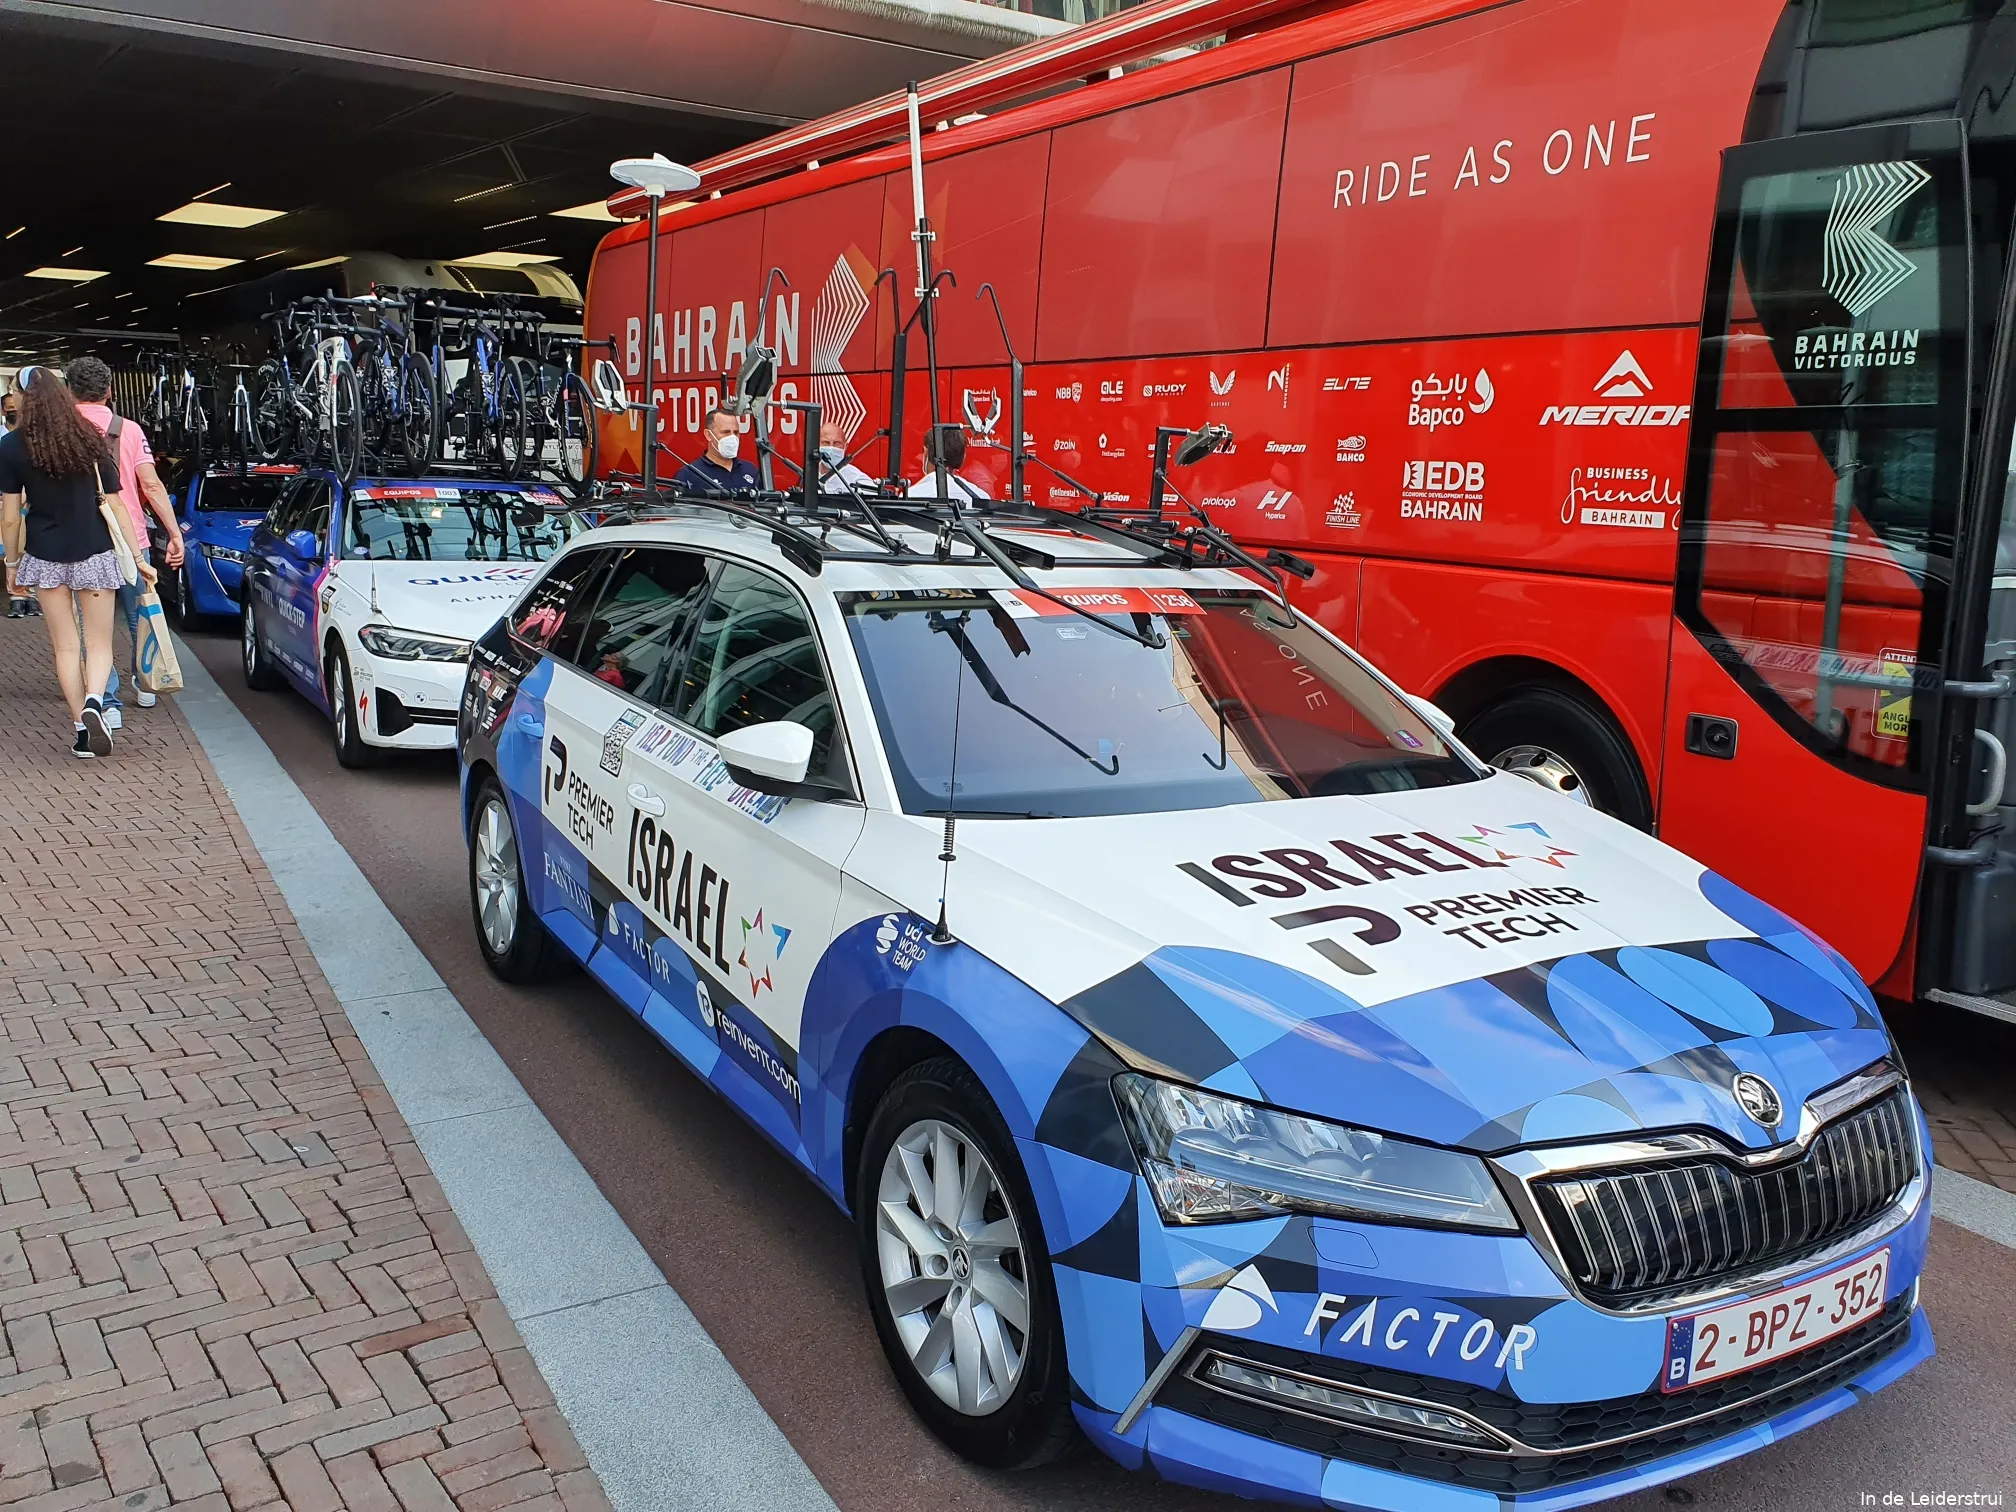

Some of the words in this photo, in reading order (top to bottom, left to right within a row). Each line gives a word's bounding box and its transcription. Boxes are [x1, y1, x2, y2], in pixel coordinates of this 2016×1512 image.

[1333, 154, 1431, 209] RIDE
[1453, 139, 1513, 190] AS
[1543, 112, 1656, 175] ONE
[626, 291, 800, 376] BAHRAIN
[1795, 329, 1920, 354] BAHRAIN
[1794, 350, 1917, 370] VICTORIOUS
[1055, 387, 1072, 400] NBB
[1154, 384, 1186, 393] RUDY
[1322, 376, 1371, 391] ELITE
[1411, 372, 1468, 402] بابكو
[1408, 403, 1464, 433] Bapco
[1264, 441, 1307, 455] Snap-on
[1336, 453, 1365, 462] BAHCO
[1426, 461, 1485, 491] EDB
[1586, 467, 1649, 480] BUSINESS
[383, 489, 422, 497] EQUIPOS
[437, 489, 459, 497] 1003
[1049, 486, 1075, 498] Continental
[1102, 491, 1130, 502] Vision
[1326, 515, 1346, 523] FINISH
[1346, 516, 1361, 524] LINE
[1400, 500, 1483, 522] BAHRAIN
[1591, 511, 1653, 525] BAHRAIN
[1153, 593, 1195, 607] 1258
[279, 597, 306, 629] QUICK-STEP
[635, 722, 672, 755] HELP
[656, 733, 697, 767] FUND
[568, 770, 614, 835] PREMIER
[567, 802, 594, 850] TECH
[1174, 831, 1510, 907] ISRAEL
[543, 851, 595, 921] FANTINI
[627, 807, 730, 977] ISRAEL
[1402, 886, 1600, 926] PREMIER
[904, 923, 923, 942] UCI
[1441, 911, 1580, 949] TECH
[623, 922, 671, 985] FACTOR
[892, 950, 913, 972] TEAM
[898, 936, 926, 961] WORLD
[715, 1008, 802, 1105] reinvent.com
[1694, 1262, 1883, 1373] 2-BPZ-352
[1303, 1291, 1538, 1371] FACTOR
[1669, 1357, 1686, 1380] B
